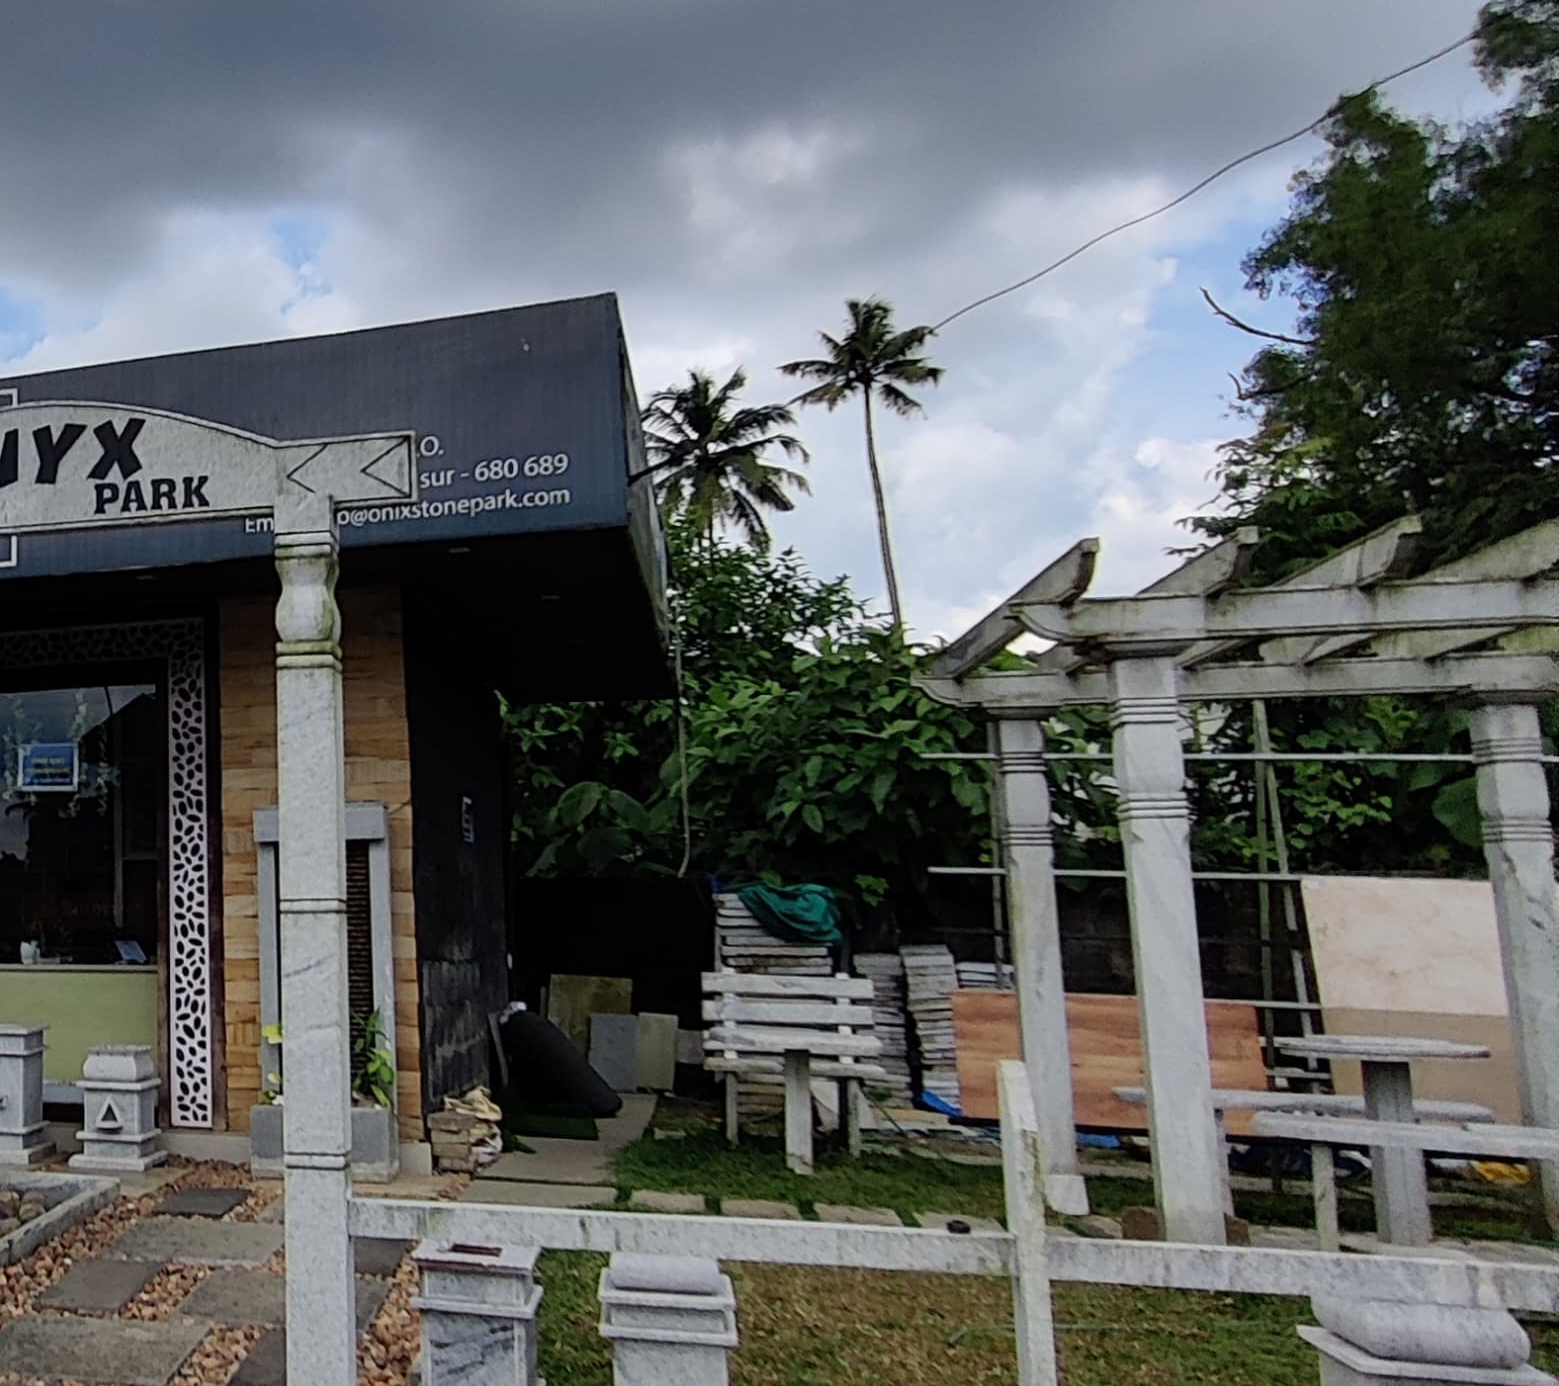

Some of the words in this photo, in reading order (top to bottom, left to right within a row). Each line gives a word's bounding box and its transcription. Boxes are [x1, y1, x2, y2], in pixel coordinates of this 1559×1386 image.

[420, 469, 456, 489] sur
[474, 458, 519, 483] 680
[523, 453, 569, 478] 689
[93, 475, 210, 515] PARK
[244, 516, 275, 534] Em
[337, 487, 571, 526] o@onixstonepark.com
